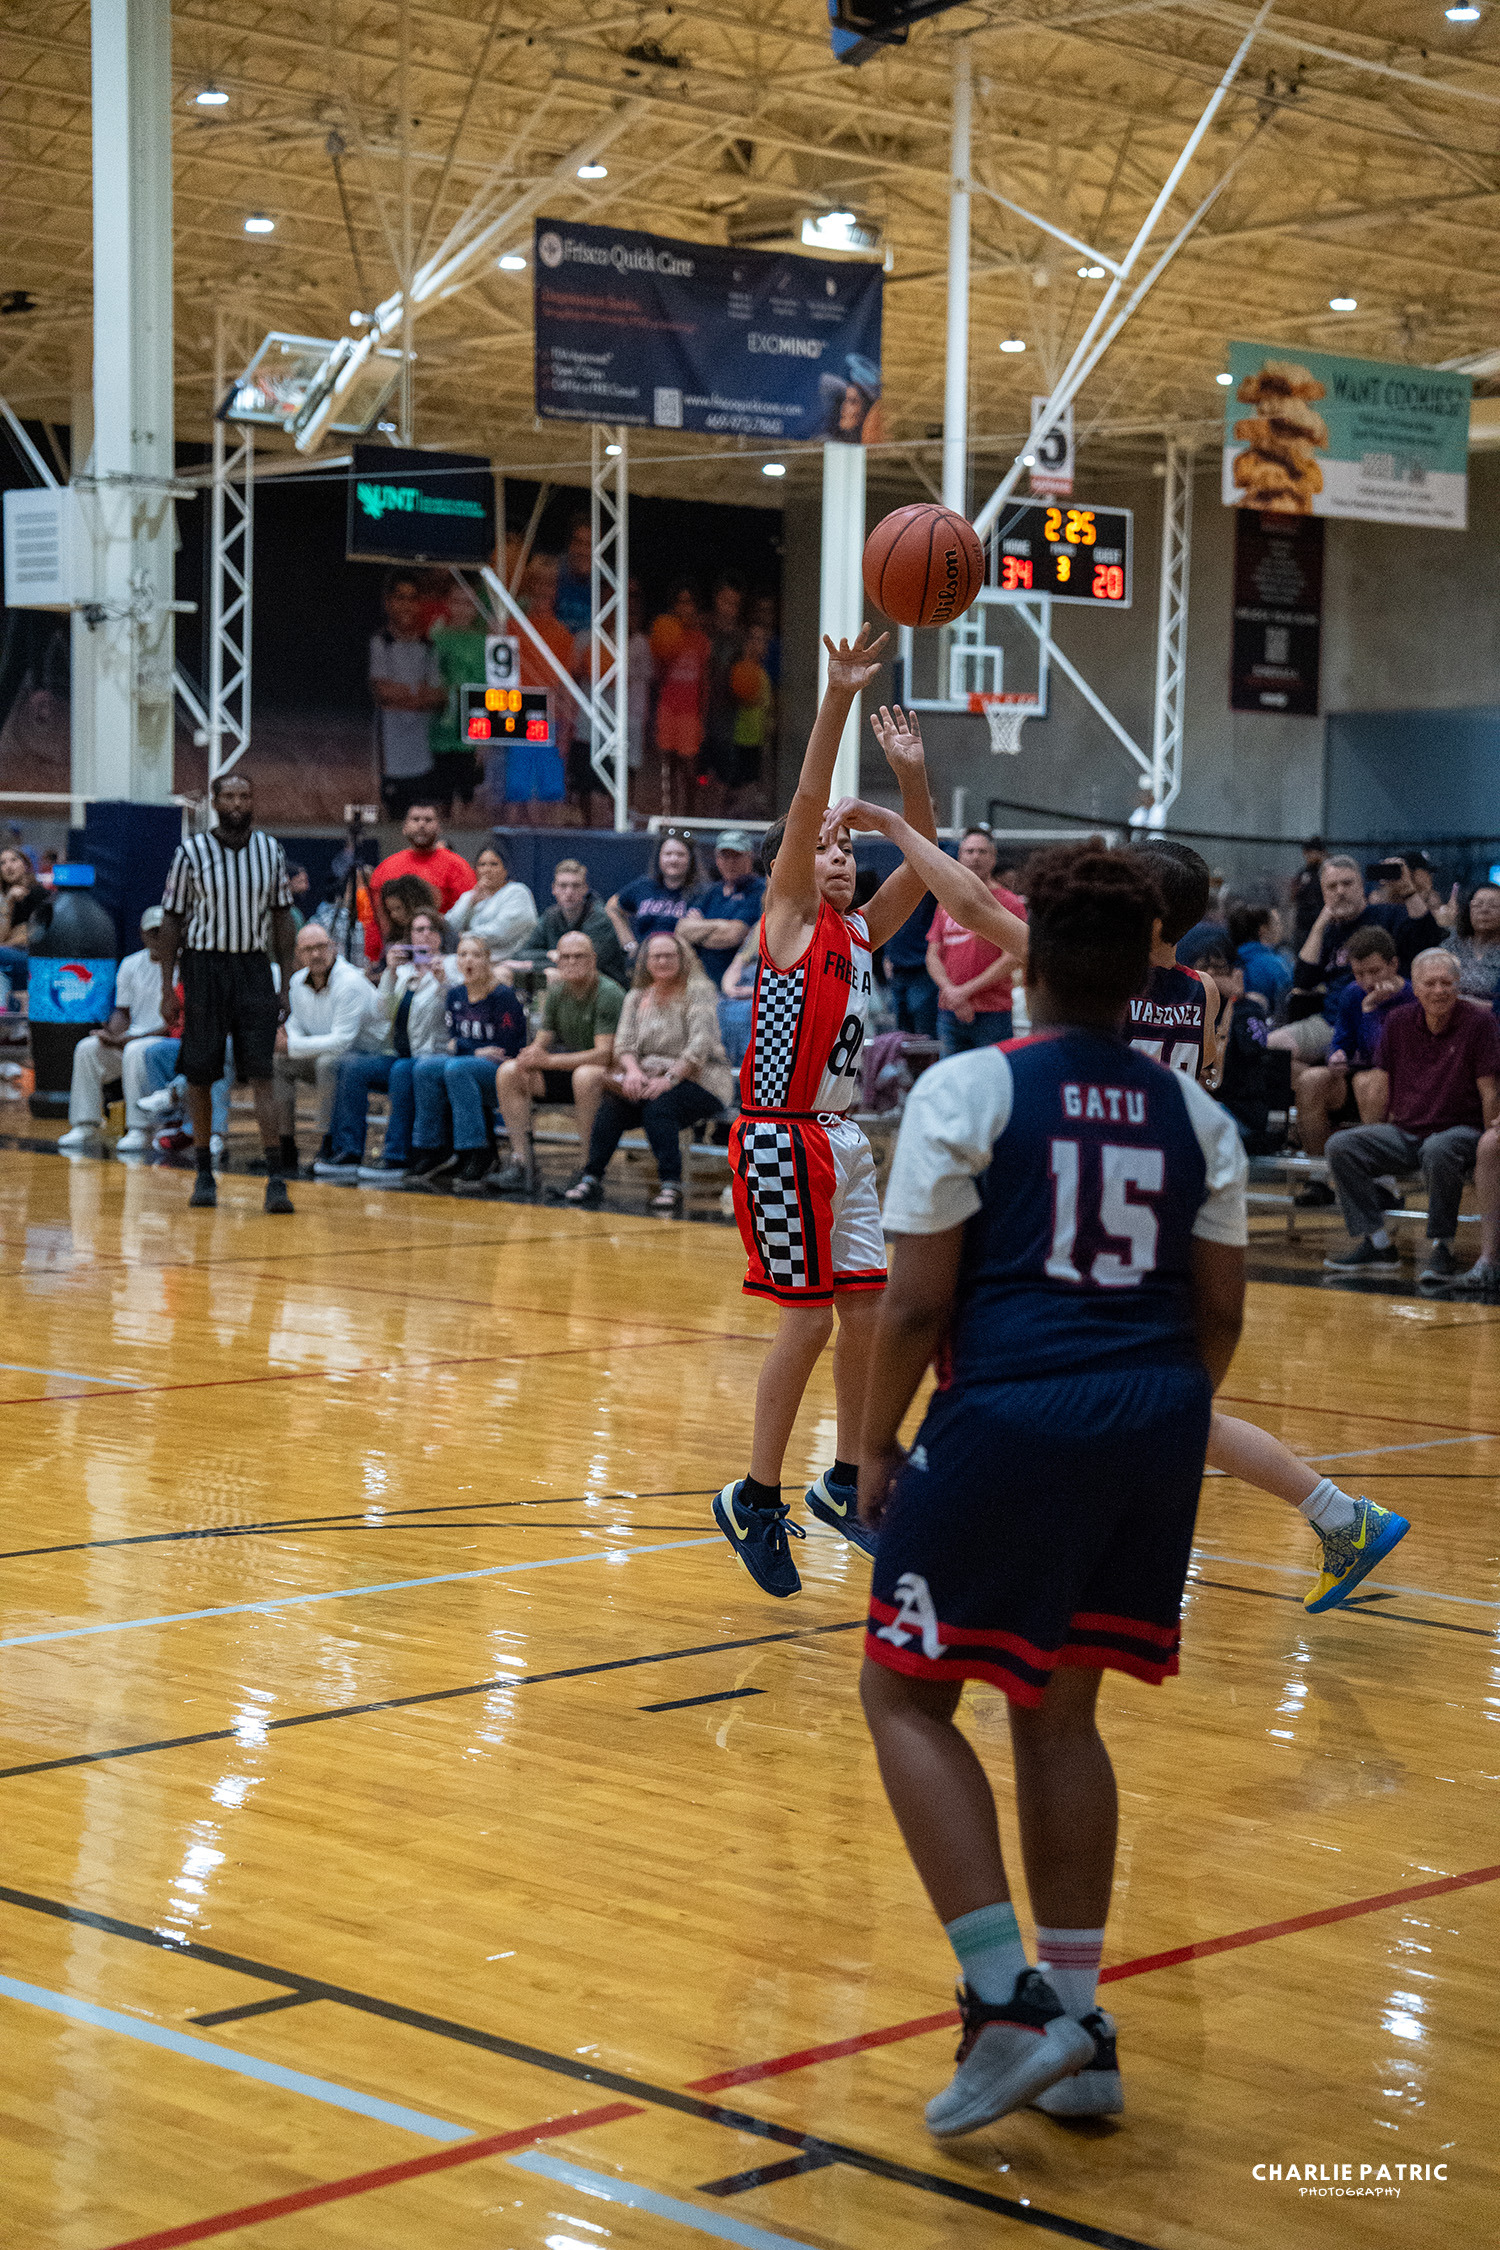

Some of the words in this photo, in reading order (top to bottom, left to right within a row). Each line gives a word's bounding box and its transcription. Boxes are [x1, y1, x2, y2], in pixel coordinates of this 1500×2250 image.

[563, 238, 610, 266] Frisco
[610, 244, 655, 275] Quick
[656, 251, 695, 277] Care
[1332, 372, 1381, 404] WANT
[927, 549, 959, 624] Wilson
[1002, 556, 1033, 590] 34
[1056, 555, 1071, 582] 3
[1092, 564, 1123, 600] 20
[493, 643, 512, 678] 9
[823, 949, 858, 990] FREE
[1129, 999, 1202, 1027] VASQUEZ
[1063, 1084, 1145, 1124] GATU
[1044, 1139, 1165, 1287] 15
[876, 1571, 948, 1660] A
